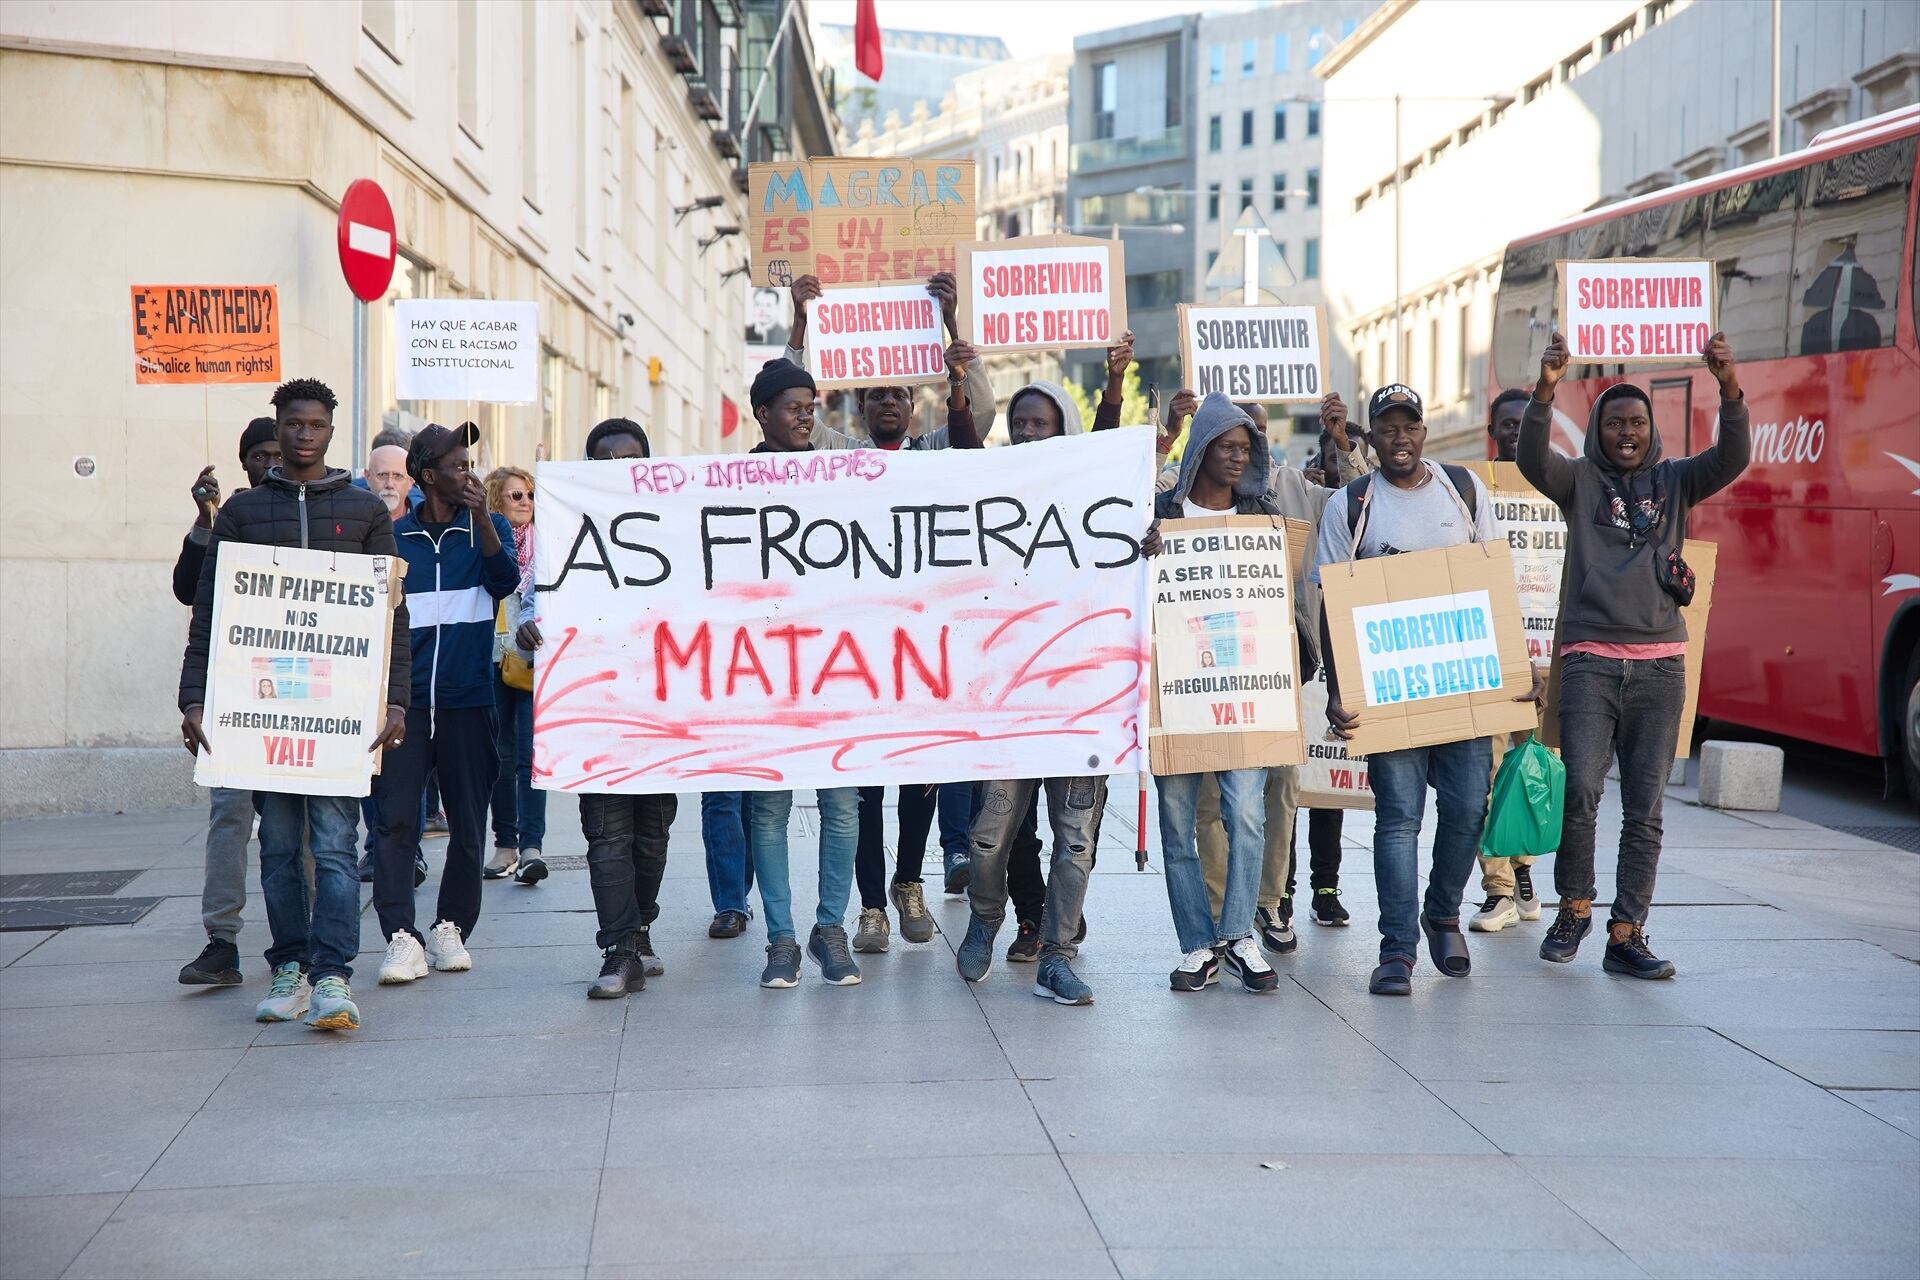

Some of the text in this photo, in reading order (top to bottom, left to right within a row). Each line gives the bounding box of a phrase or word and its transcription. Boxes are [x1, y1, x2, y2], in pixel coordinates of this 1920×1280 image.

[762, 216, 883, 253] ES UN
[983, 262, 1103, 298] SOBREVIVIR
[1578, 277, 1703, 309] SOBREVIVIR
[165, 288, 272, 334] APARTHEID?
[411, 319, 518, 332] HAY QUE ACABAR
[817, 299, 935, 335] SOBREVIVIR
[983, 308, 1109, 345] NO ES DELITO
[411, 338, 518, 350] CON EL RACISMO
[1196, 318, 1310, 350] SOBREVIVIR
[1577, 322, 1709, 356] NO ES DELITO
[195, 356, 232, 373] human
[236, 355, 273, 376] rights!
[411, 357, 515, 369] INSTITUCIONAL
[820, 342, 943, 379] NO ES DELITO
[1199, 363, 1318, 396] NO ES DELITO
[630, 462, 687, 494] RED
[700, 496, 1140, 590] FRONTERAS
[1192, 535, 1282, 551] OBLIGAN
[1508, 530, 1528, 549] ES
[234, 570, 274, 598] SIN
[279, 575, 375, 608] PAPELES
[1157, 564, 1283, 584] A SER ILEGAL
[1157, 584, 1285, 604] AL MENOS 3 AÑOS
[285, 609, 318, 627] NOS
[1366, 607, 1487, 655] SOBREVIVIR
[228, 624, 370, 658] CRIMINALIZAN
[652, 620, 951, 701] MATAN
[1162, 672, 1292, 695] #REGULARIZACIÓN
[1372, 654, 1501, 704] NO ES DELITO
[219, 711, 362, 736] #REGULARIZACIÓN
[1211, 703, 1237, 726] YA
[263, 736, 316, 768] YA!!
[1330, 769, 1353, 789] YA
